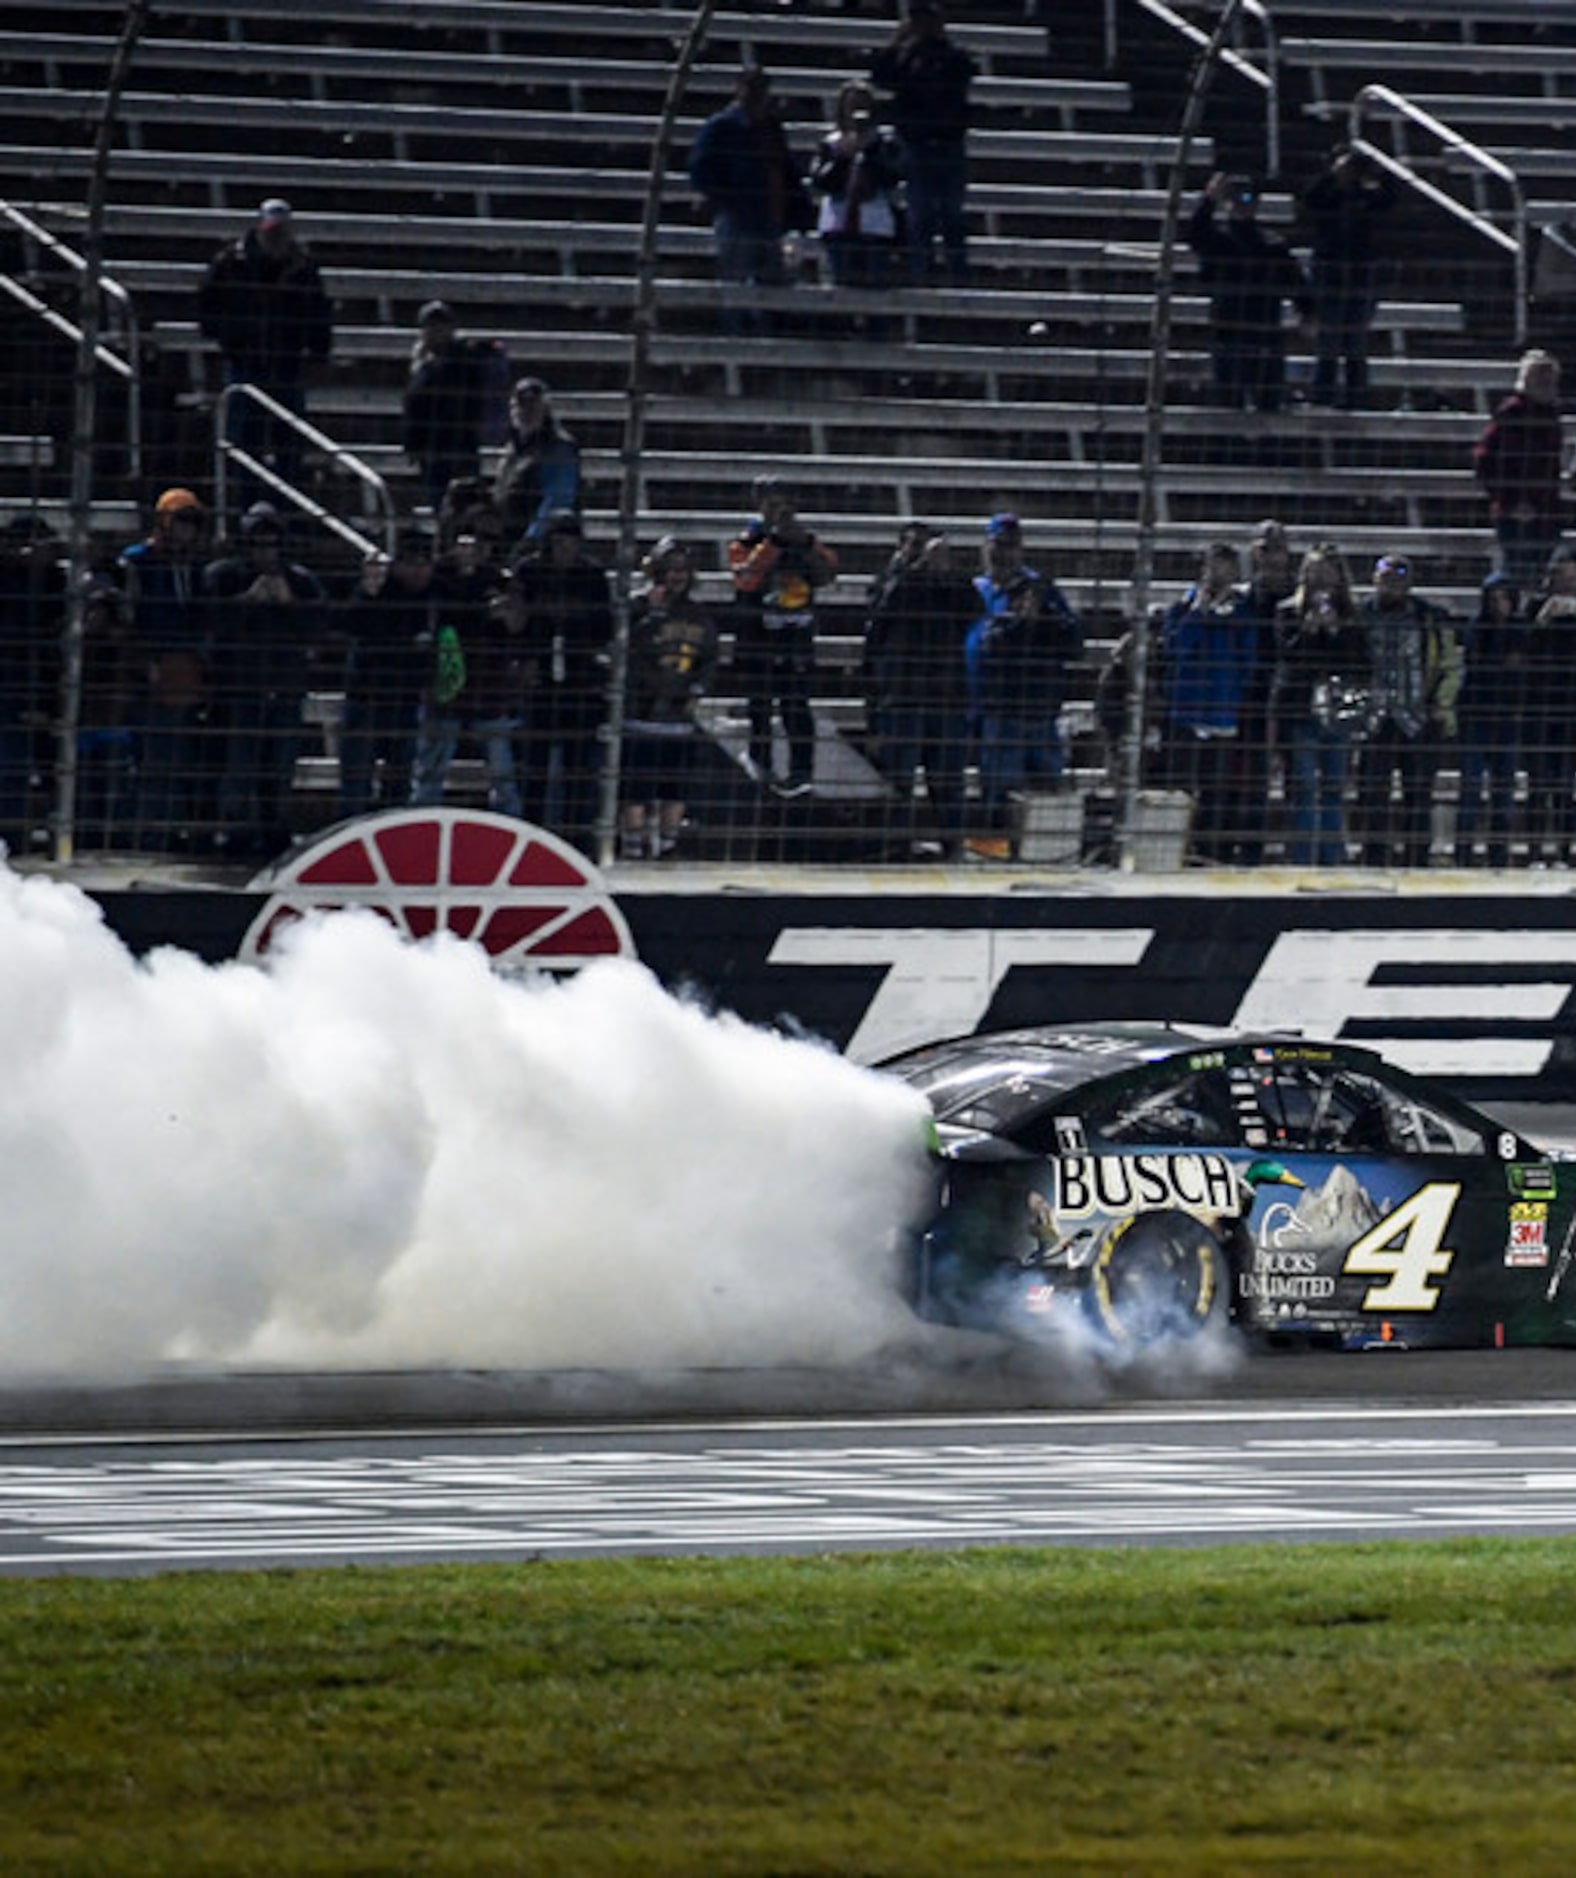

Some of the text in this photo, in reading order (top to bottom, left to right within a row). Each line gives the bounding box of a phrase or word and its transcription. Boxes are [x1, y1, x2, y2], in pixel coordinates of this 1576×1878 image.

[1497, 1131, 1518, 1160] 8
[1057, 1153, 1238, 1213] BUSCH
[1342, 1181, 1462, 1312] 4
[1514, 1224, 1543, 1245] 3M
[1254, 1249, 1317, 1274] DUCKS
[1238, 1273, 1335, 1299] UNLIMITED
